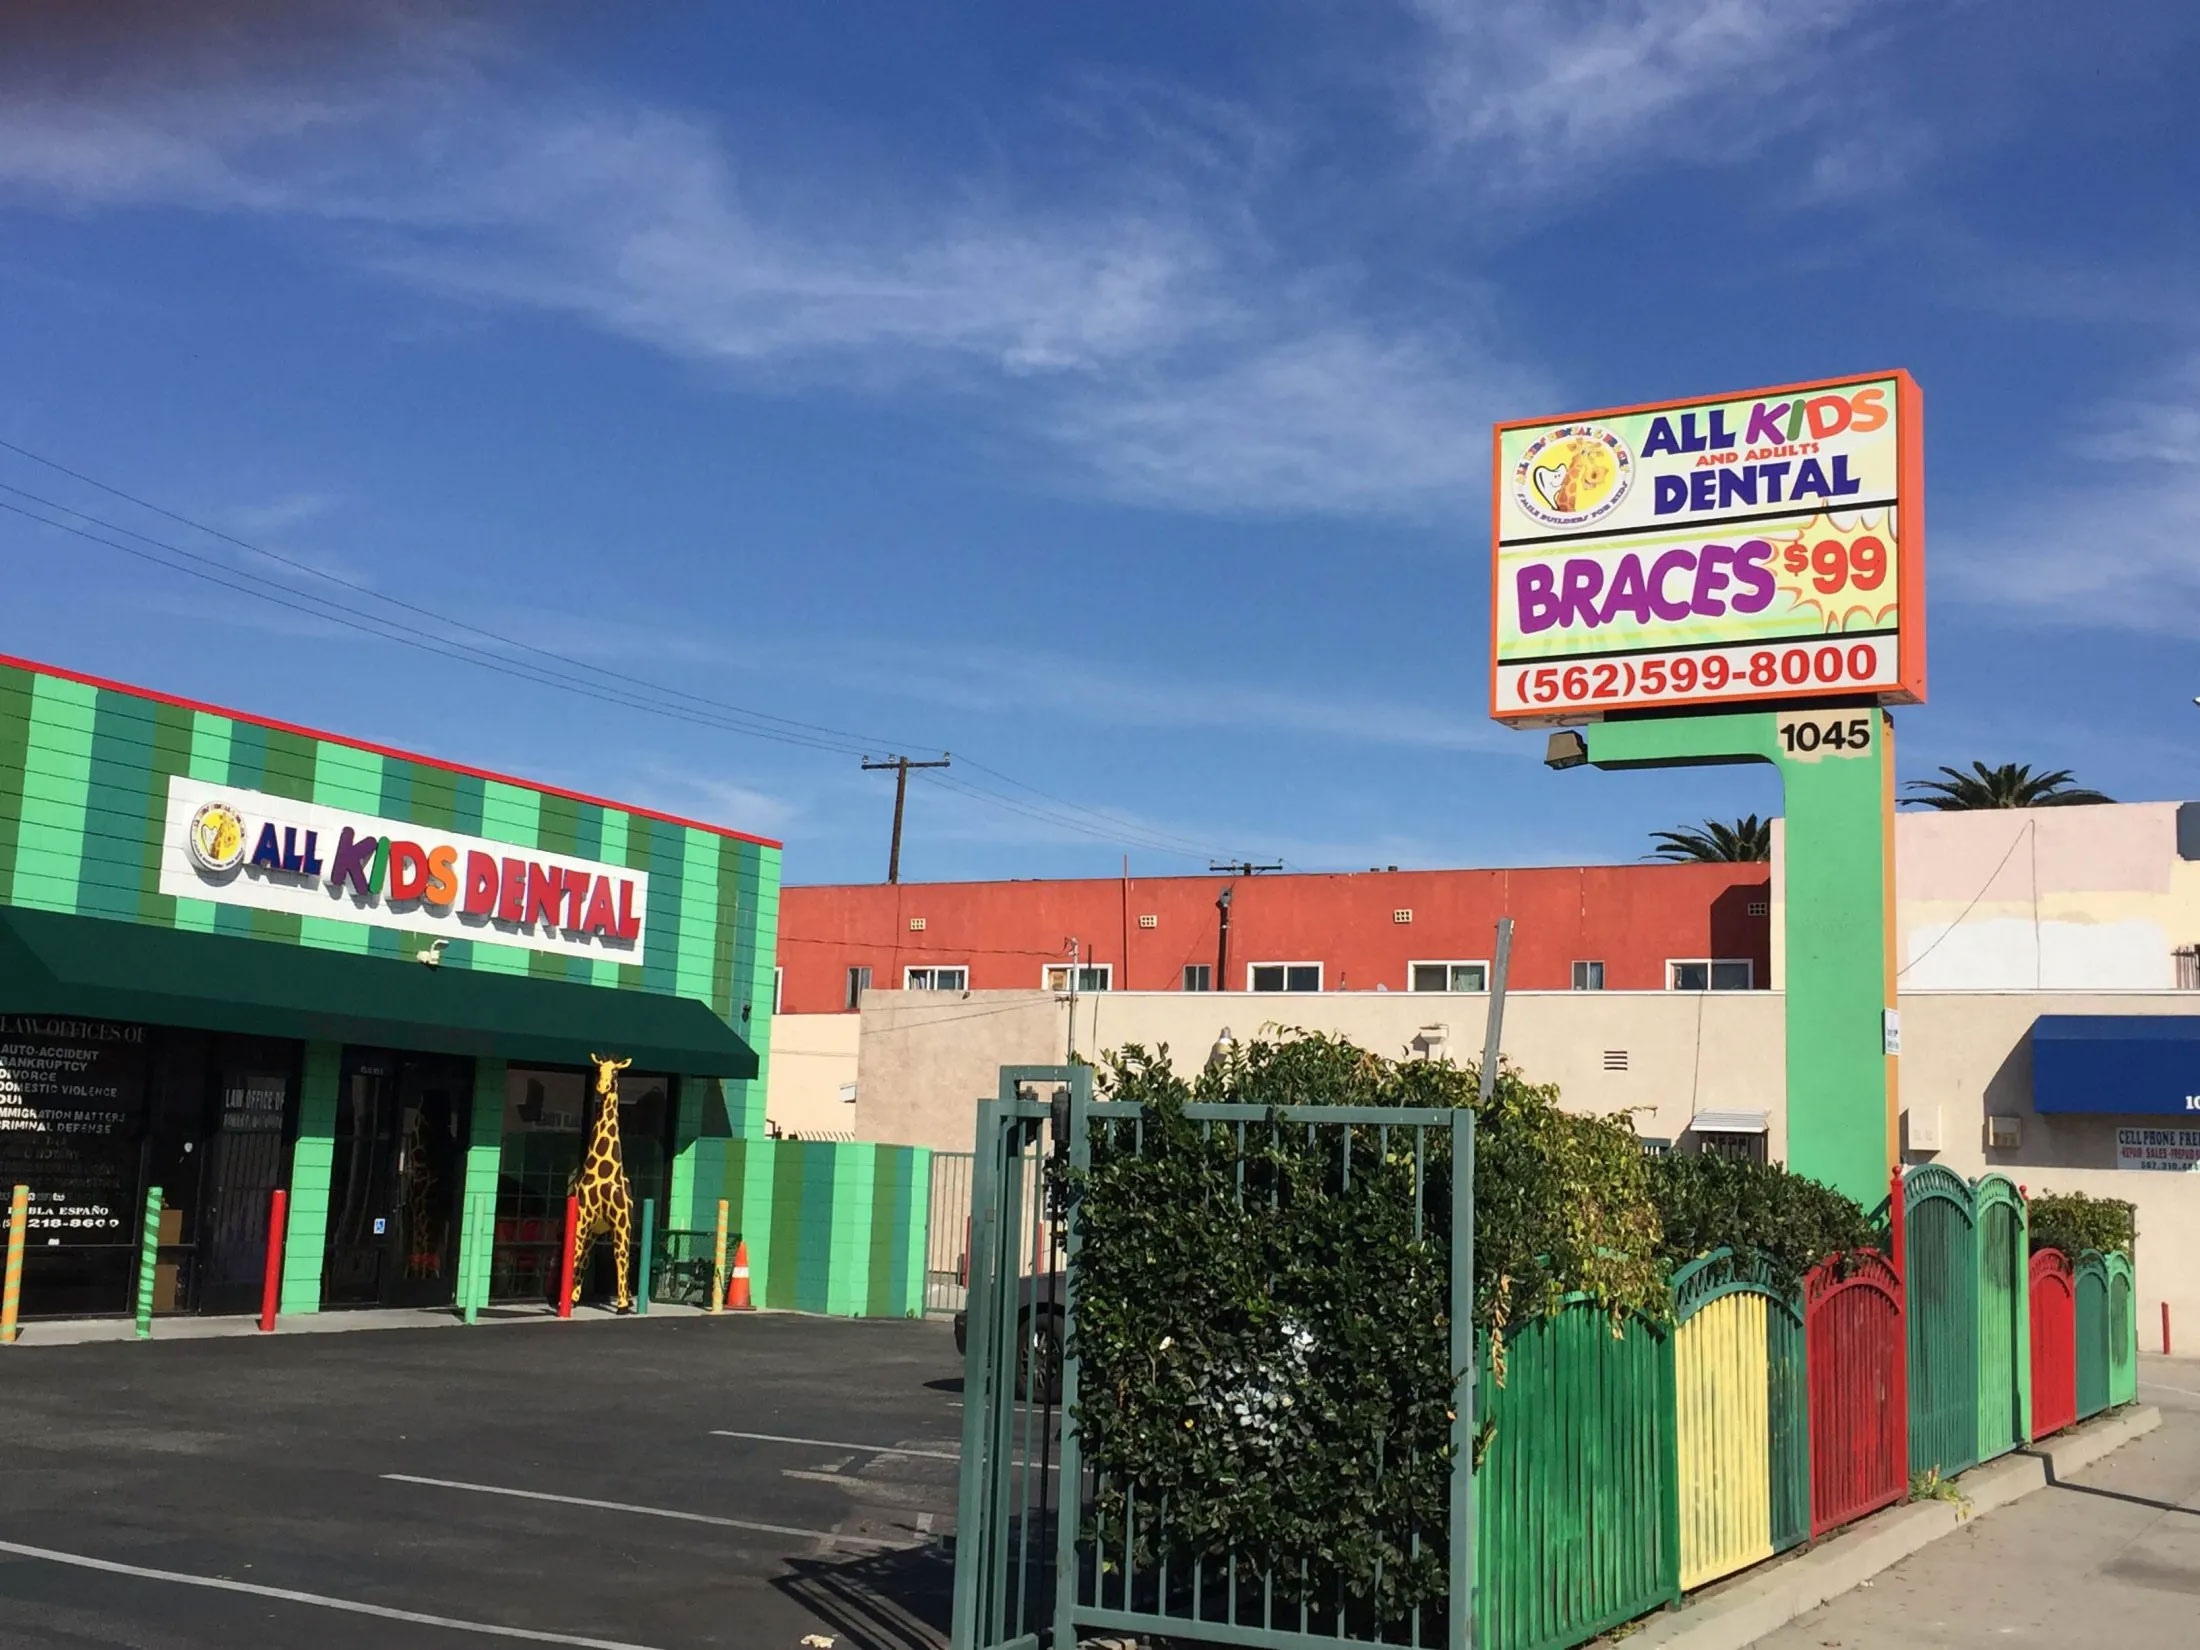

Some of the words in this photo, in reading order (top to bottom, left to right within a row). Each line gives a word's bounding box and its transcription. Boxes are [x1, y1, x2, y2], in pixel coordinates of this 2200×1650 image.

[1641, 409, 1736, 458] ALL
[1745, 388, 1889, 446] KIDS
[1695, 450, 1739, 468] AND
[1743, 442, 1820, 462] ADULTS
[1653, 454, 1861, 516] DENTAL
[1784, 535, 1887, 595] $99
[1516, 540, 1776, 635] BRACES
[1517, 644, 1877, 704] (562)599-8000
[1780, 719, 1870, 752] 1045
[250, 822, 324, 876] ALL
[330, 826, 457, 905] KIDS
[464, 848, 642, 940] DENTAL
[1, 1016, 38, 1034] LAW
[47, 1019, 121, 1041] OFFICES
[1, 1044, 99, 1060] AUTO-ACCIDENT
[0, 1056, 88, 1072] BANKRUPTCY
[0, 1069, 57, 1082] DIVORCE
[0, 1094, 22, 1105] DUI
[61, 1085, 118, 1098] VIOLENCE
[0, 1107, 70, 1119] MMIGRATION
[0, 1120, 53, 1132] RIMINAL
[57, 1122, 112, 1134] DEFENSE
[2119, 1130, 2142, 1145] CELL
[2143, 1131, 2176, 1146] PHONE
[2146, 1148, 2167, 1159] SALES
[59, 1205, 109, 1215] ESPAÑO
